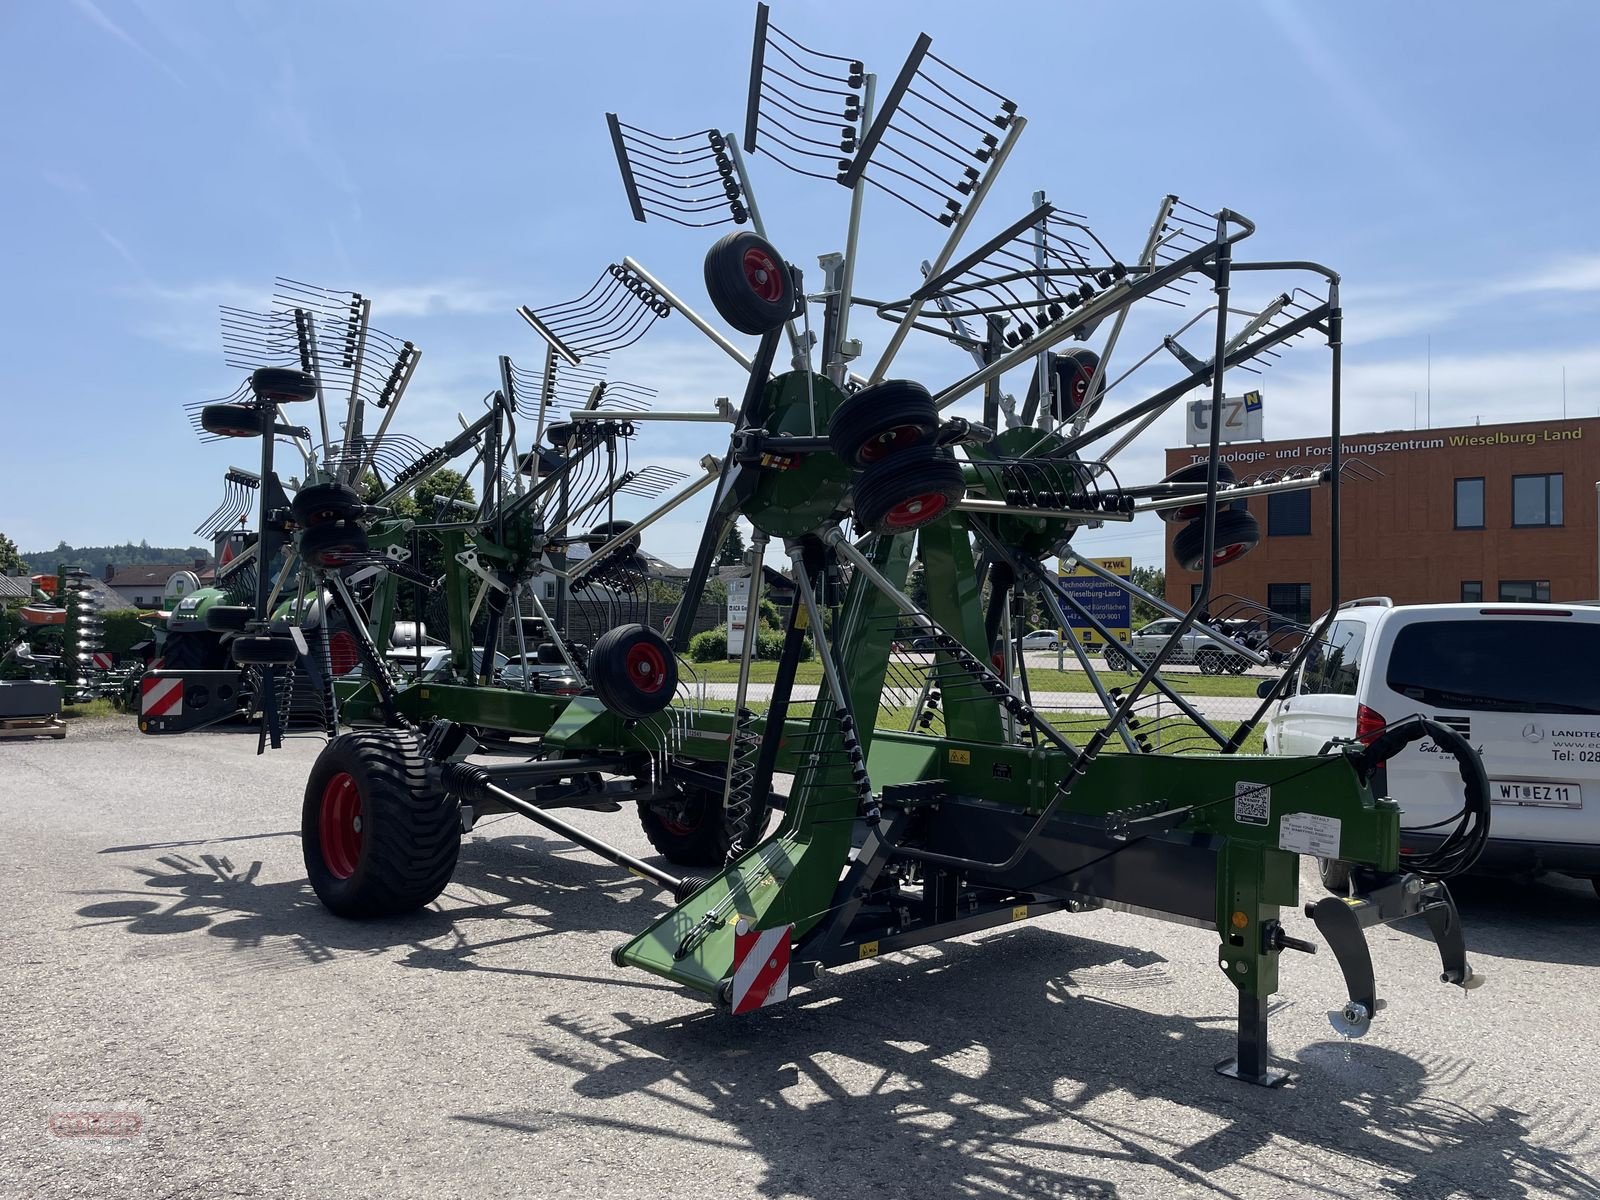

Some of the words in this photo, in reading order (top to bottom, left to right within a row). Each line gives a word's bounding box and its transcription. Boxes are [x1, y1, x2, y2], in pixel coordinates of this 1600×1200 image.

[1190, 399, 1244, 430] tz
[1190, 449, 1271, 465] Tecnologie-
[1275, 446, 1300, 459] und
[1305, 438, 1444, 457] Forshungszentrum
[1449, 427, 1582, 447] Wieselburg-Land
[1062, 580, 1115, 590] Technologiezent
[1065, 590, 1121, 598] Wieselburg-Land
[1419, 742, 1438, 753] Edi
[1552, 749, 1575, 761] Tel:
[1579, 751, 1600, 762] 028
[1500, 785, 1520, 799] WT
[1533, 786, 1552, 800] EZ
[1555, 787, 1569, 801] 11
